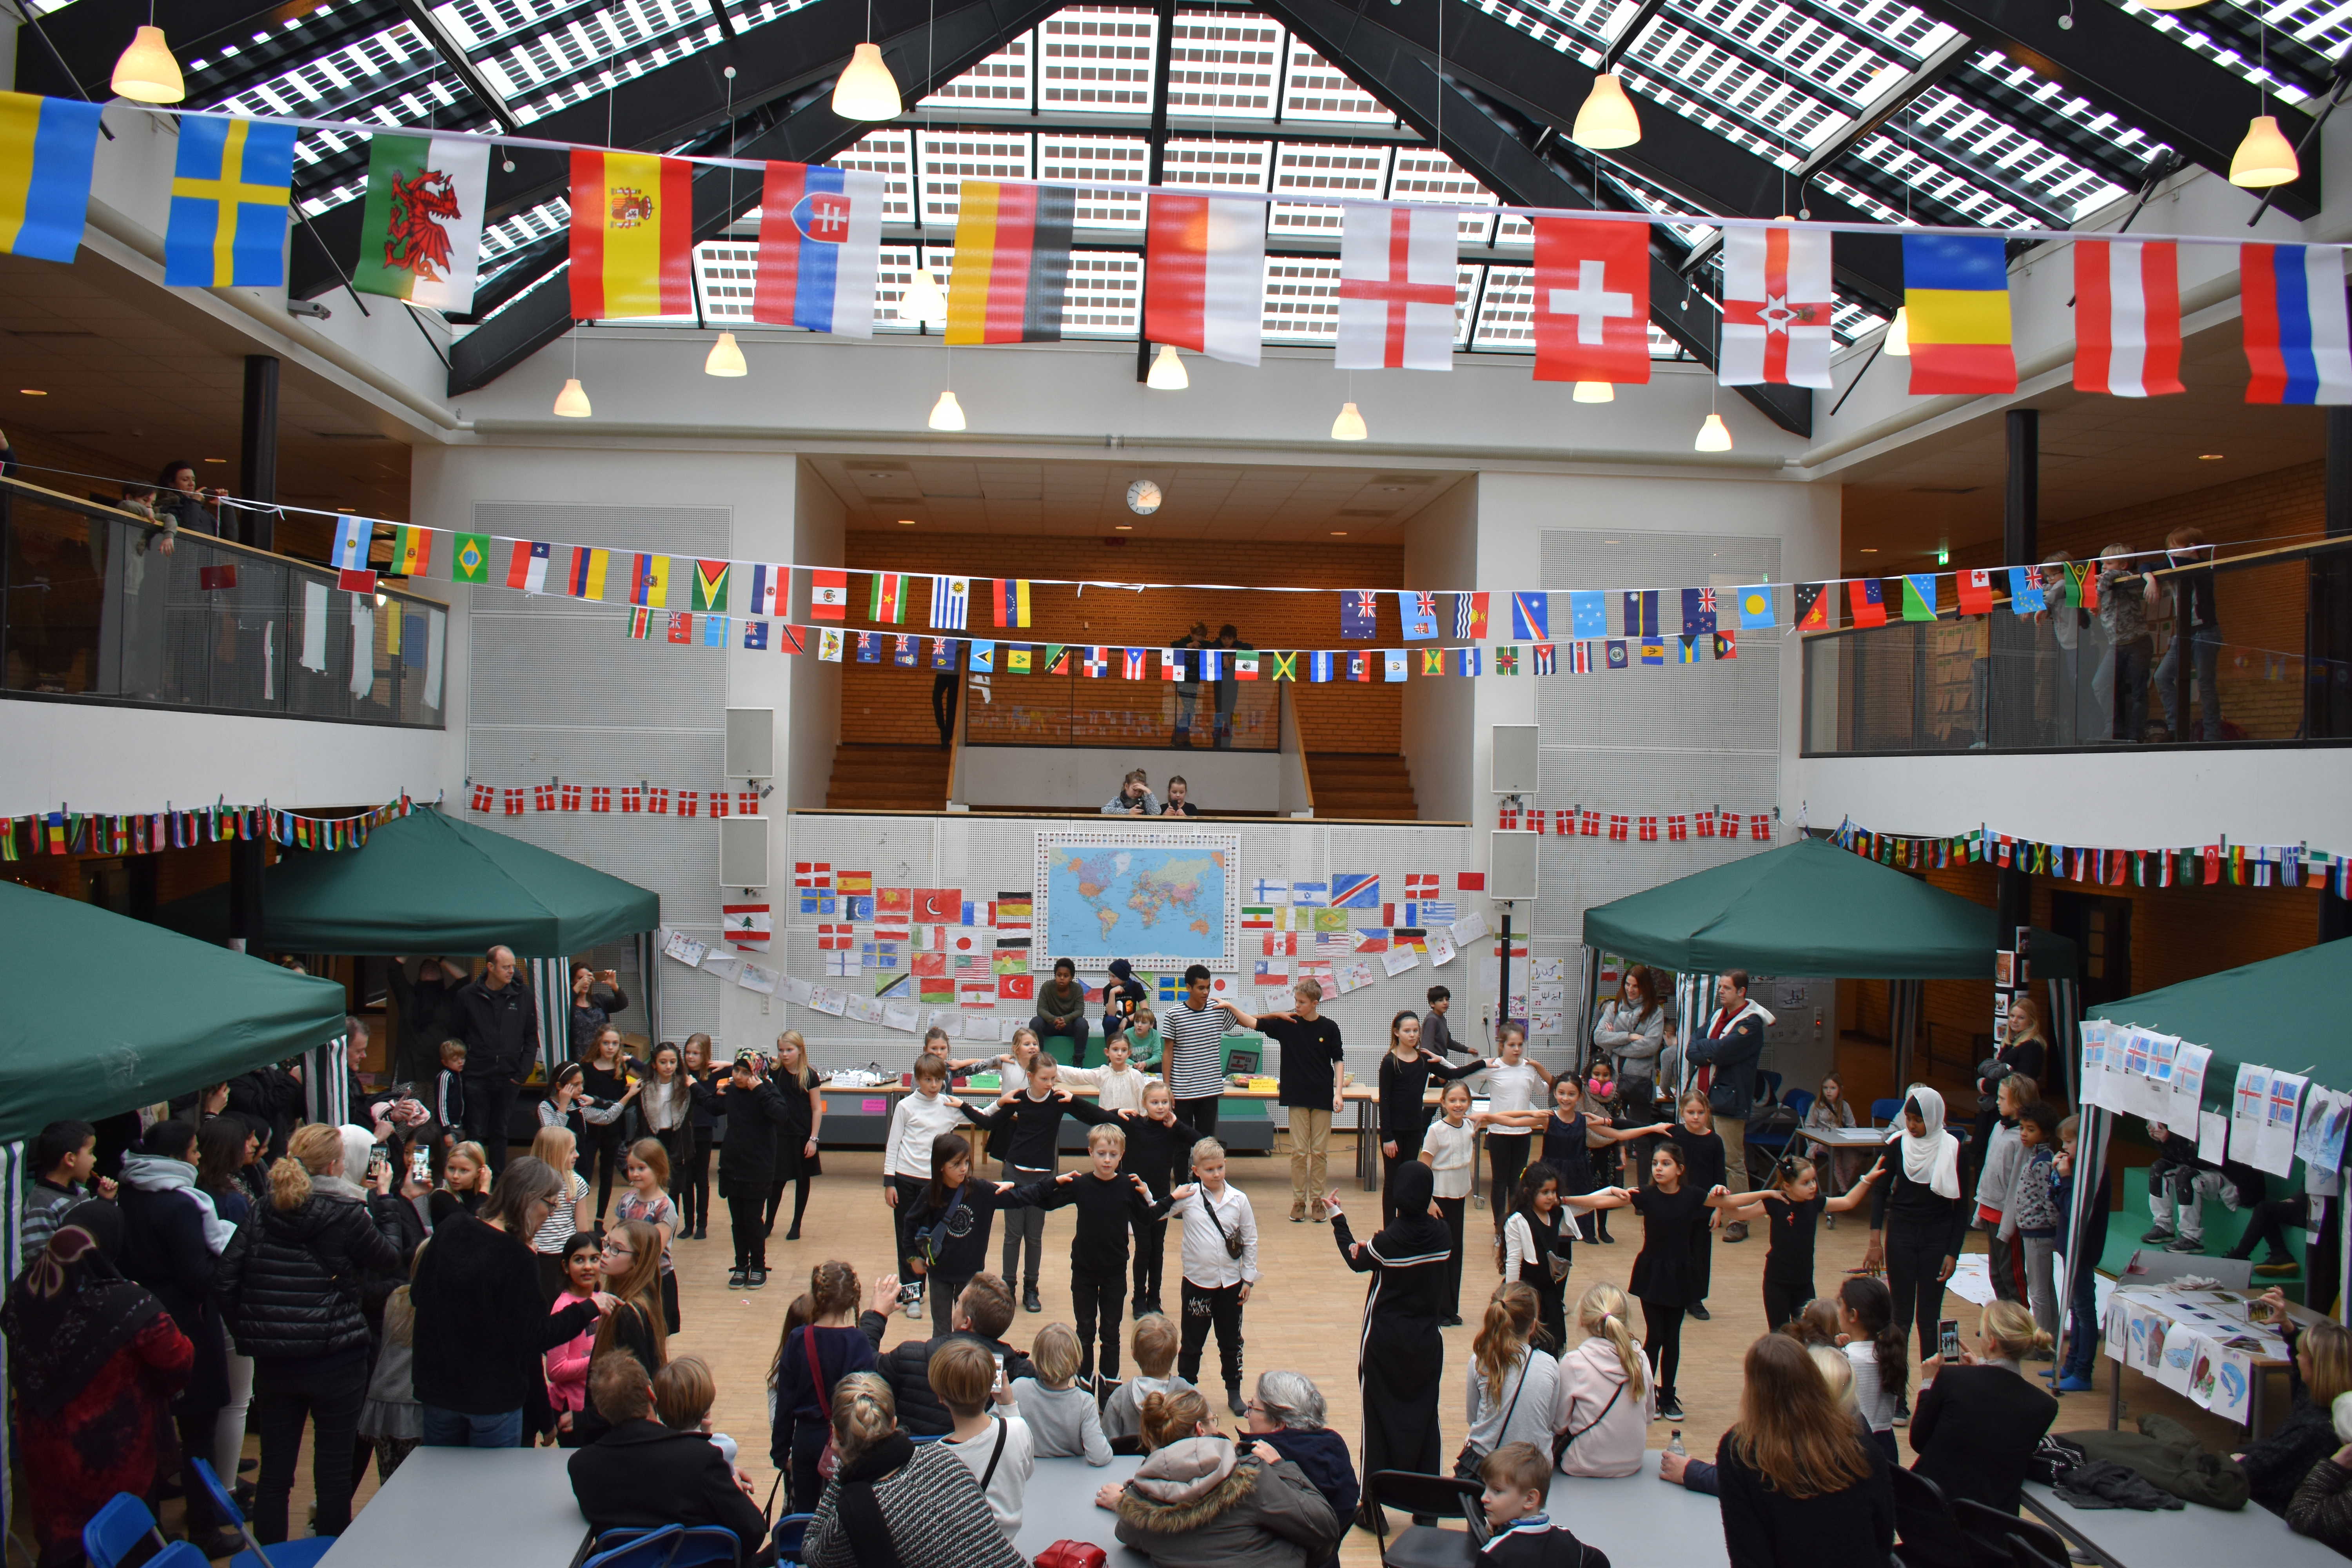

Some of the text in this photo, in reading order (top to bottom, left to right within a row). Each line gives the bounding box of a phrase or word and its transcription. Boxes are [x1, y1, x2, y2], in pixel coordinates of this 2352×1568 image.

[957, 1204, 973, 1215] STRIAN
[1189, 1297, 1203, 1309] NEW
[1192, 1304, 1211, 1316] YORK
